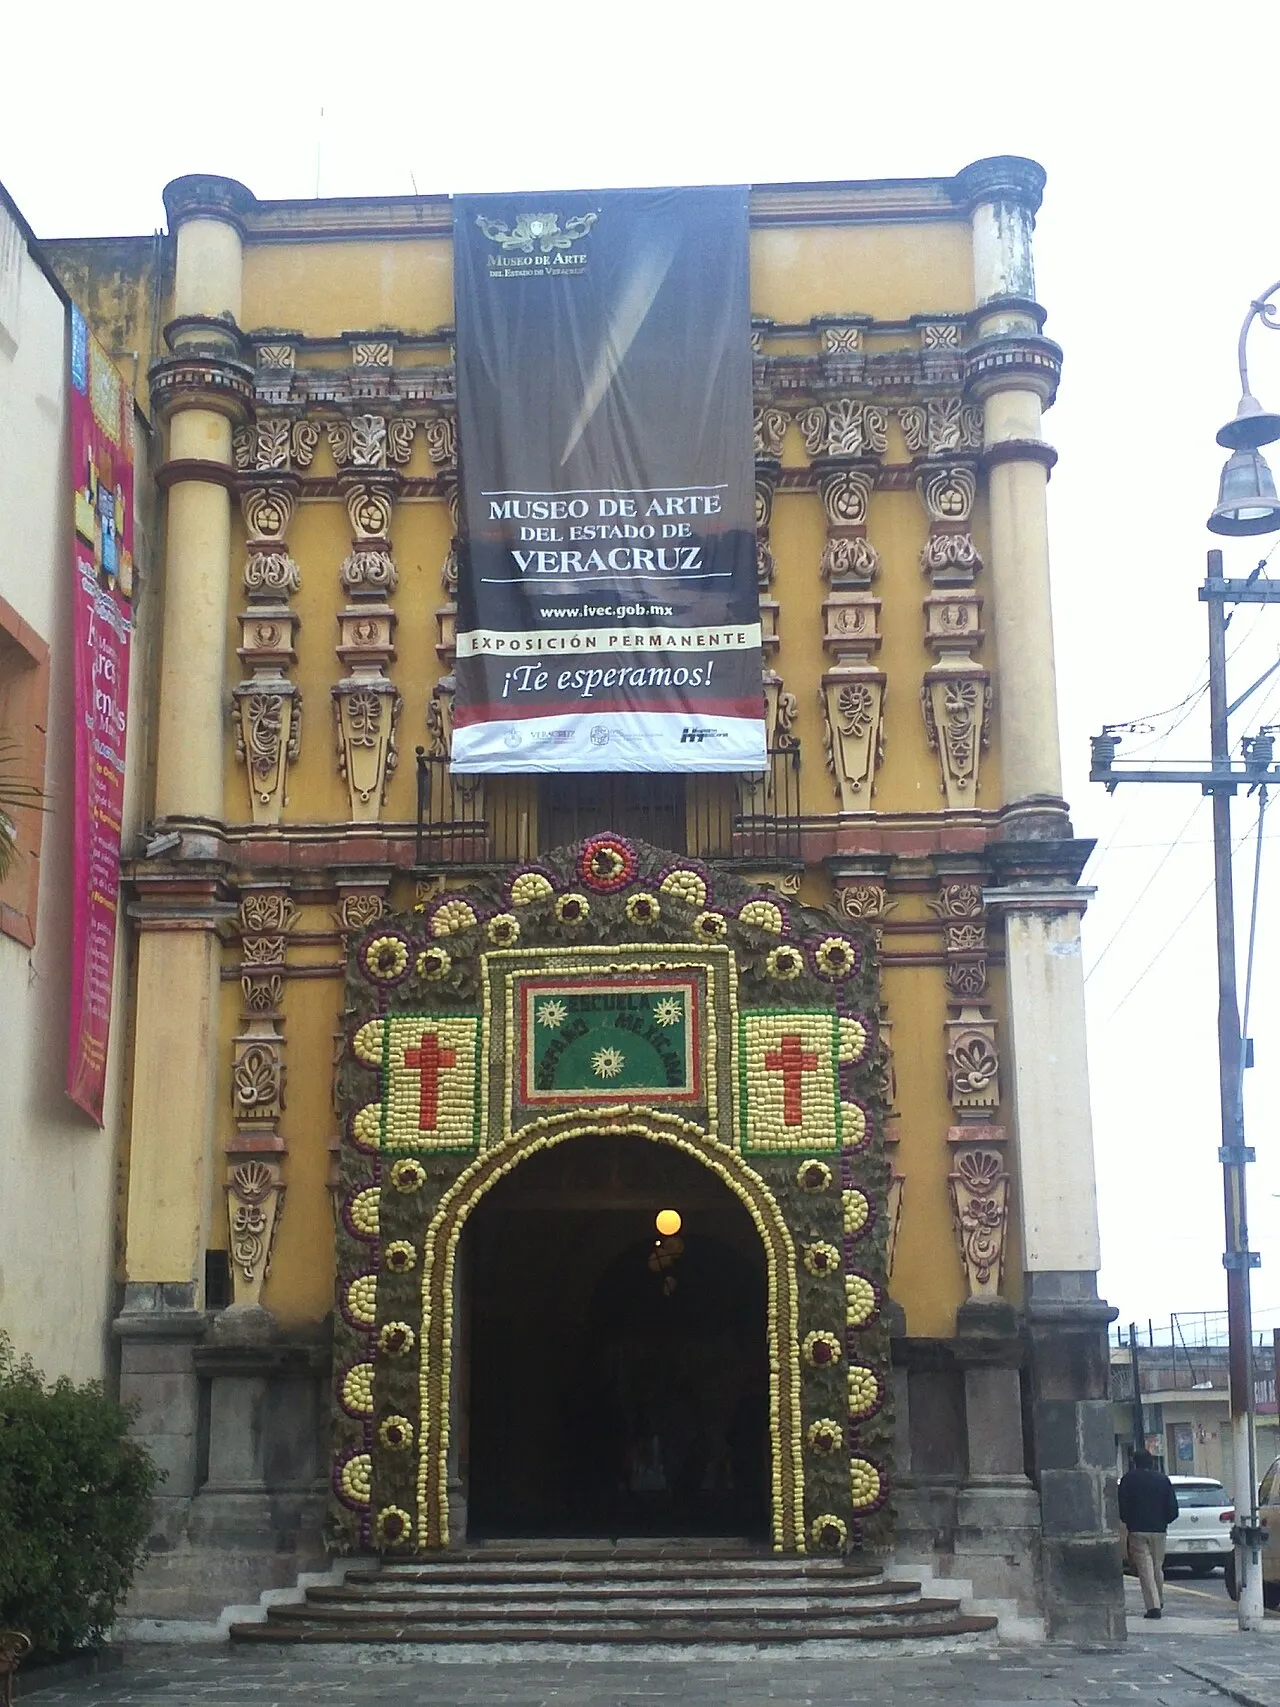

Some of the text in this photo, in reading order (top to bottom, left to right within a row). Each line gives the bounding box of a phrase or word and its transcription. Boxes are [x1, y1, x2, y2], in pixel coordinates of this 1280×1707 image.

[487, 252, 588, 266] MUSEO DE ARTE
[490, 270, 504, 278] DEL
[504, 268, 533, 278] ESTADO
[488, 494, 722, 521] MUSEO DE ARTE
[520, 523, 692, 542] DEL ESTADO DE
[511, 546, 703, 574] VERACRUZ
[540, 603, 674, 620] www.ivec.gob.mx
[472, 632, 747, 651] EXPOSICIÓN PERMANENTE
[502, 660, 715, 698] ¡Te esperamos!
[568, 993, 650, 1012] ESCUELA
[615, 1012, 684, 1088] MEXICANA
